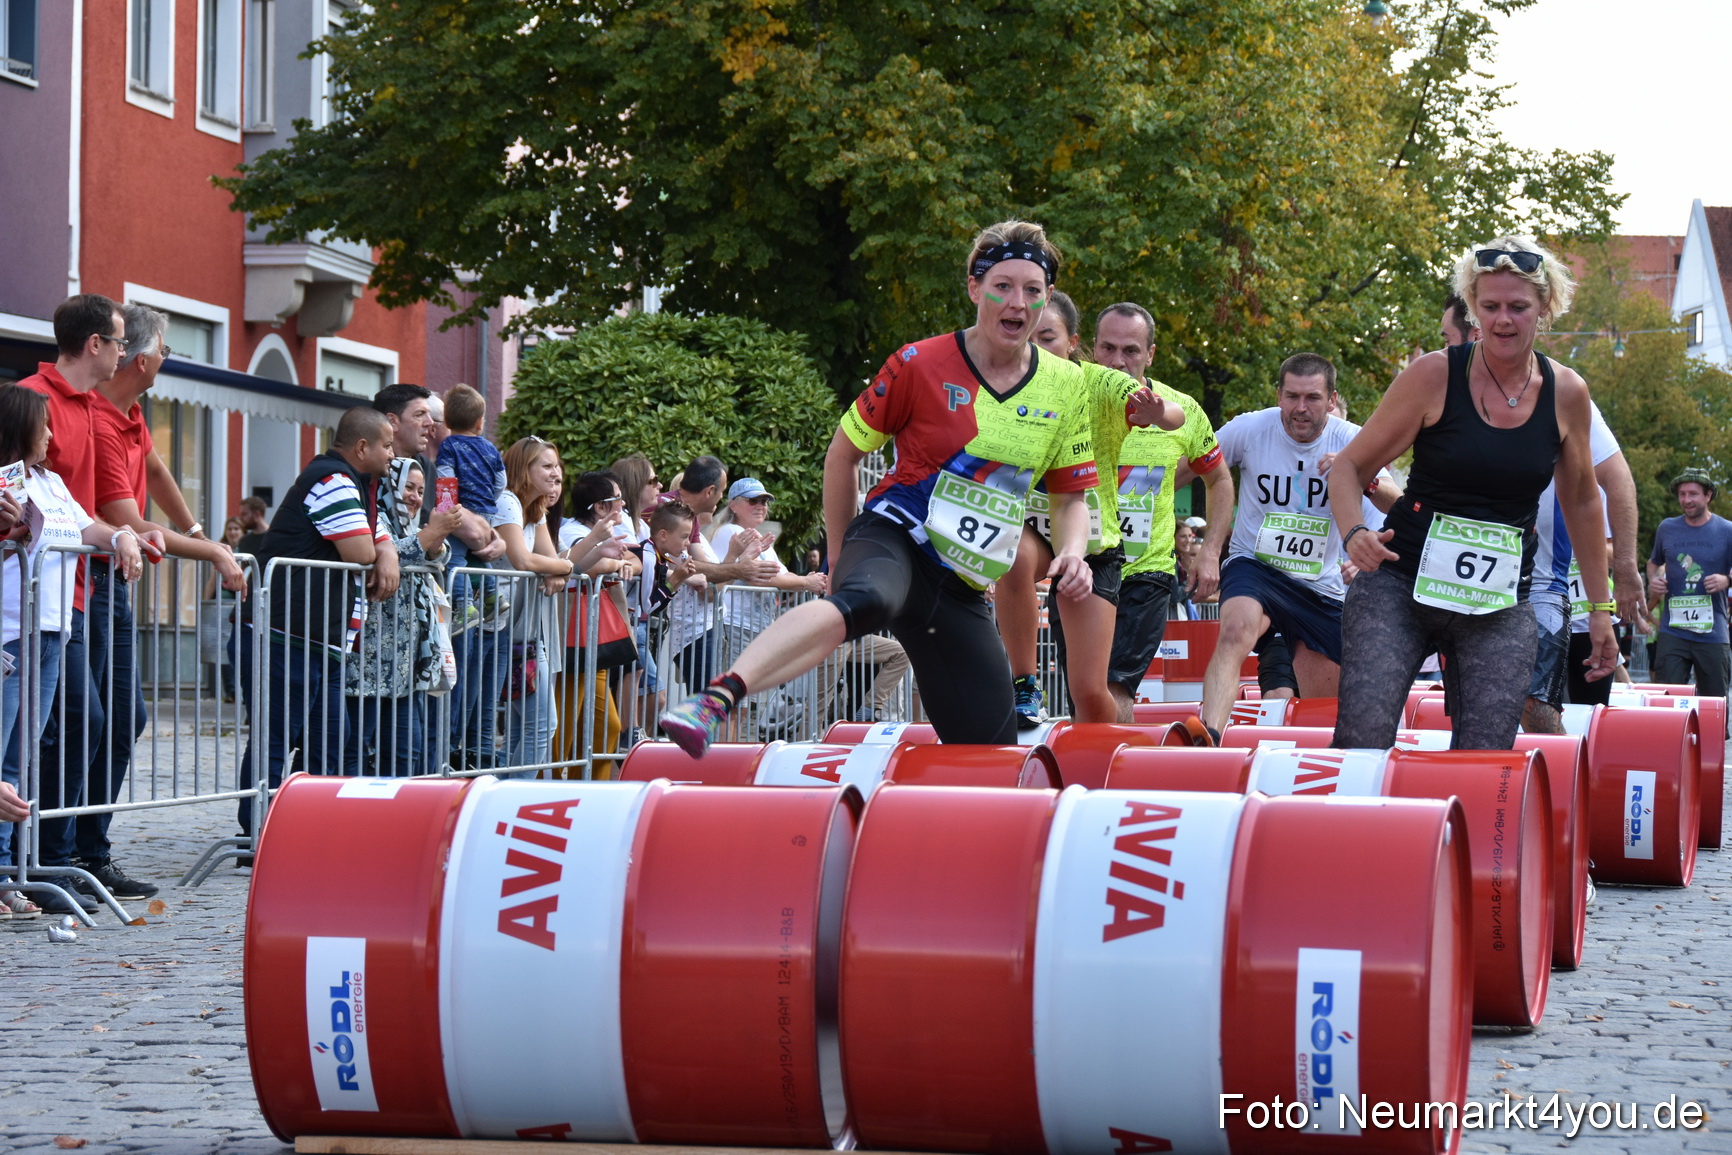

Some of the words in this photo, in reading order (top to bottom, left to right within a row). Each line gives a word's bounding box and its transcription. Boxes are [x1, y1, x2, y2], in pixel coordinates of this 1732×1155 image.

[943, 480, 1020, 522] BOCK
[957, 516, 1000, 550] 87
[1269, 515, 1325, 534] BOCK
[1437, 518, 1518, 552] BOCK
[946, 545, 985, 573] ULLA
[1275, 535, 1313, 557] 140
[1267, 557, 1311, 572] JOHANN
[1455, 551, 1498, 584] 67
[1426, 581, 1505, 606] ANNA-MARIA
[1671, 597, 1709, 607] BOCK
[1682, 609, 1699, 621] 14
[353, 971, 364, 1033] energie
